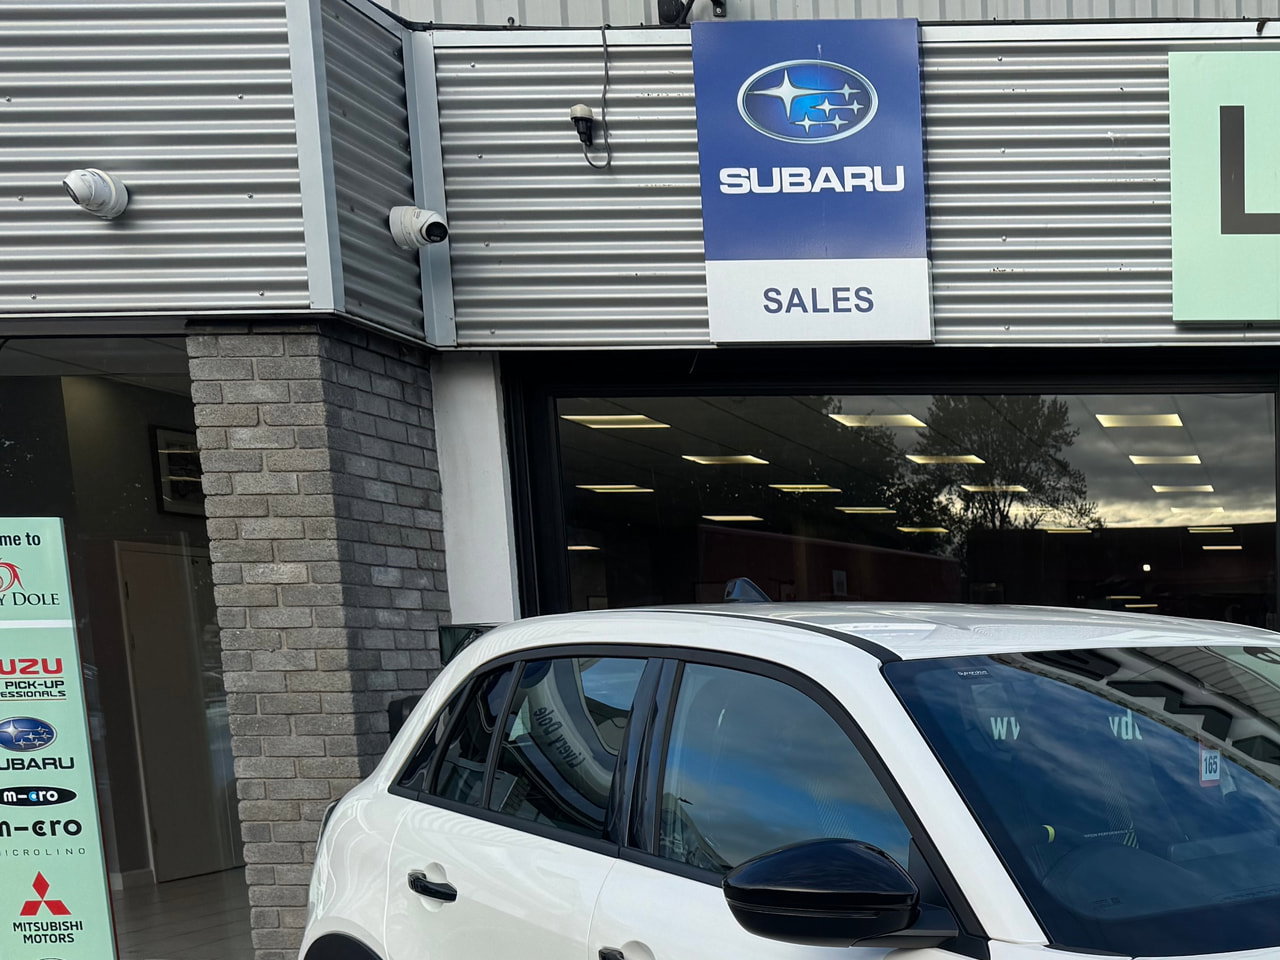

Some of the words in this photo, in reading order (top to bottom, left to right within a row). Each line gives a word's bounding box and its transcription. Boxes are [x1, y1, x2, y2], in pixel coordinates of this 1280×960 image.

[719, 165, 905, 194] SUBARU
[763, 286, 875, 313] SALES
[0, 534, 21, 546] me
[25, 532, 41, 546] to
[12, 592, 60, 606] DOLE
[0, 657, 63, 676] UZU
[5, 680, 65, 690] PICK-UP
[0, 690, 67, 698] ESSIONALS
[0, 757, 75, 771] UBARU
[0, 847, 86, 857] ICROLINO
[13, 921, 83, 932] MITSUBISHI
[23, 933, 75, 944] MOTORS
